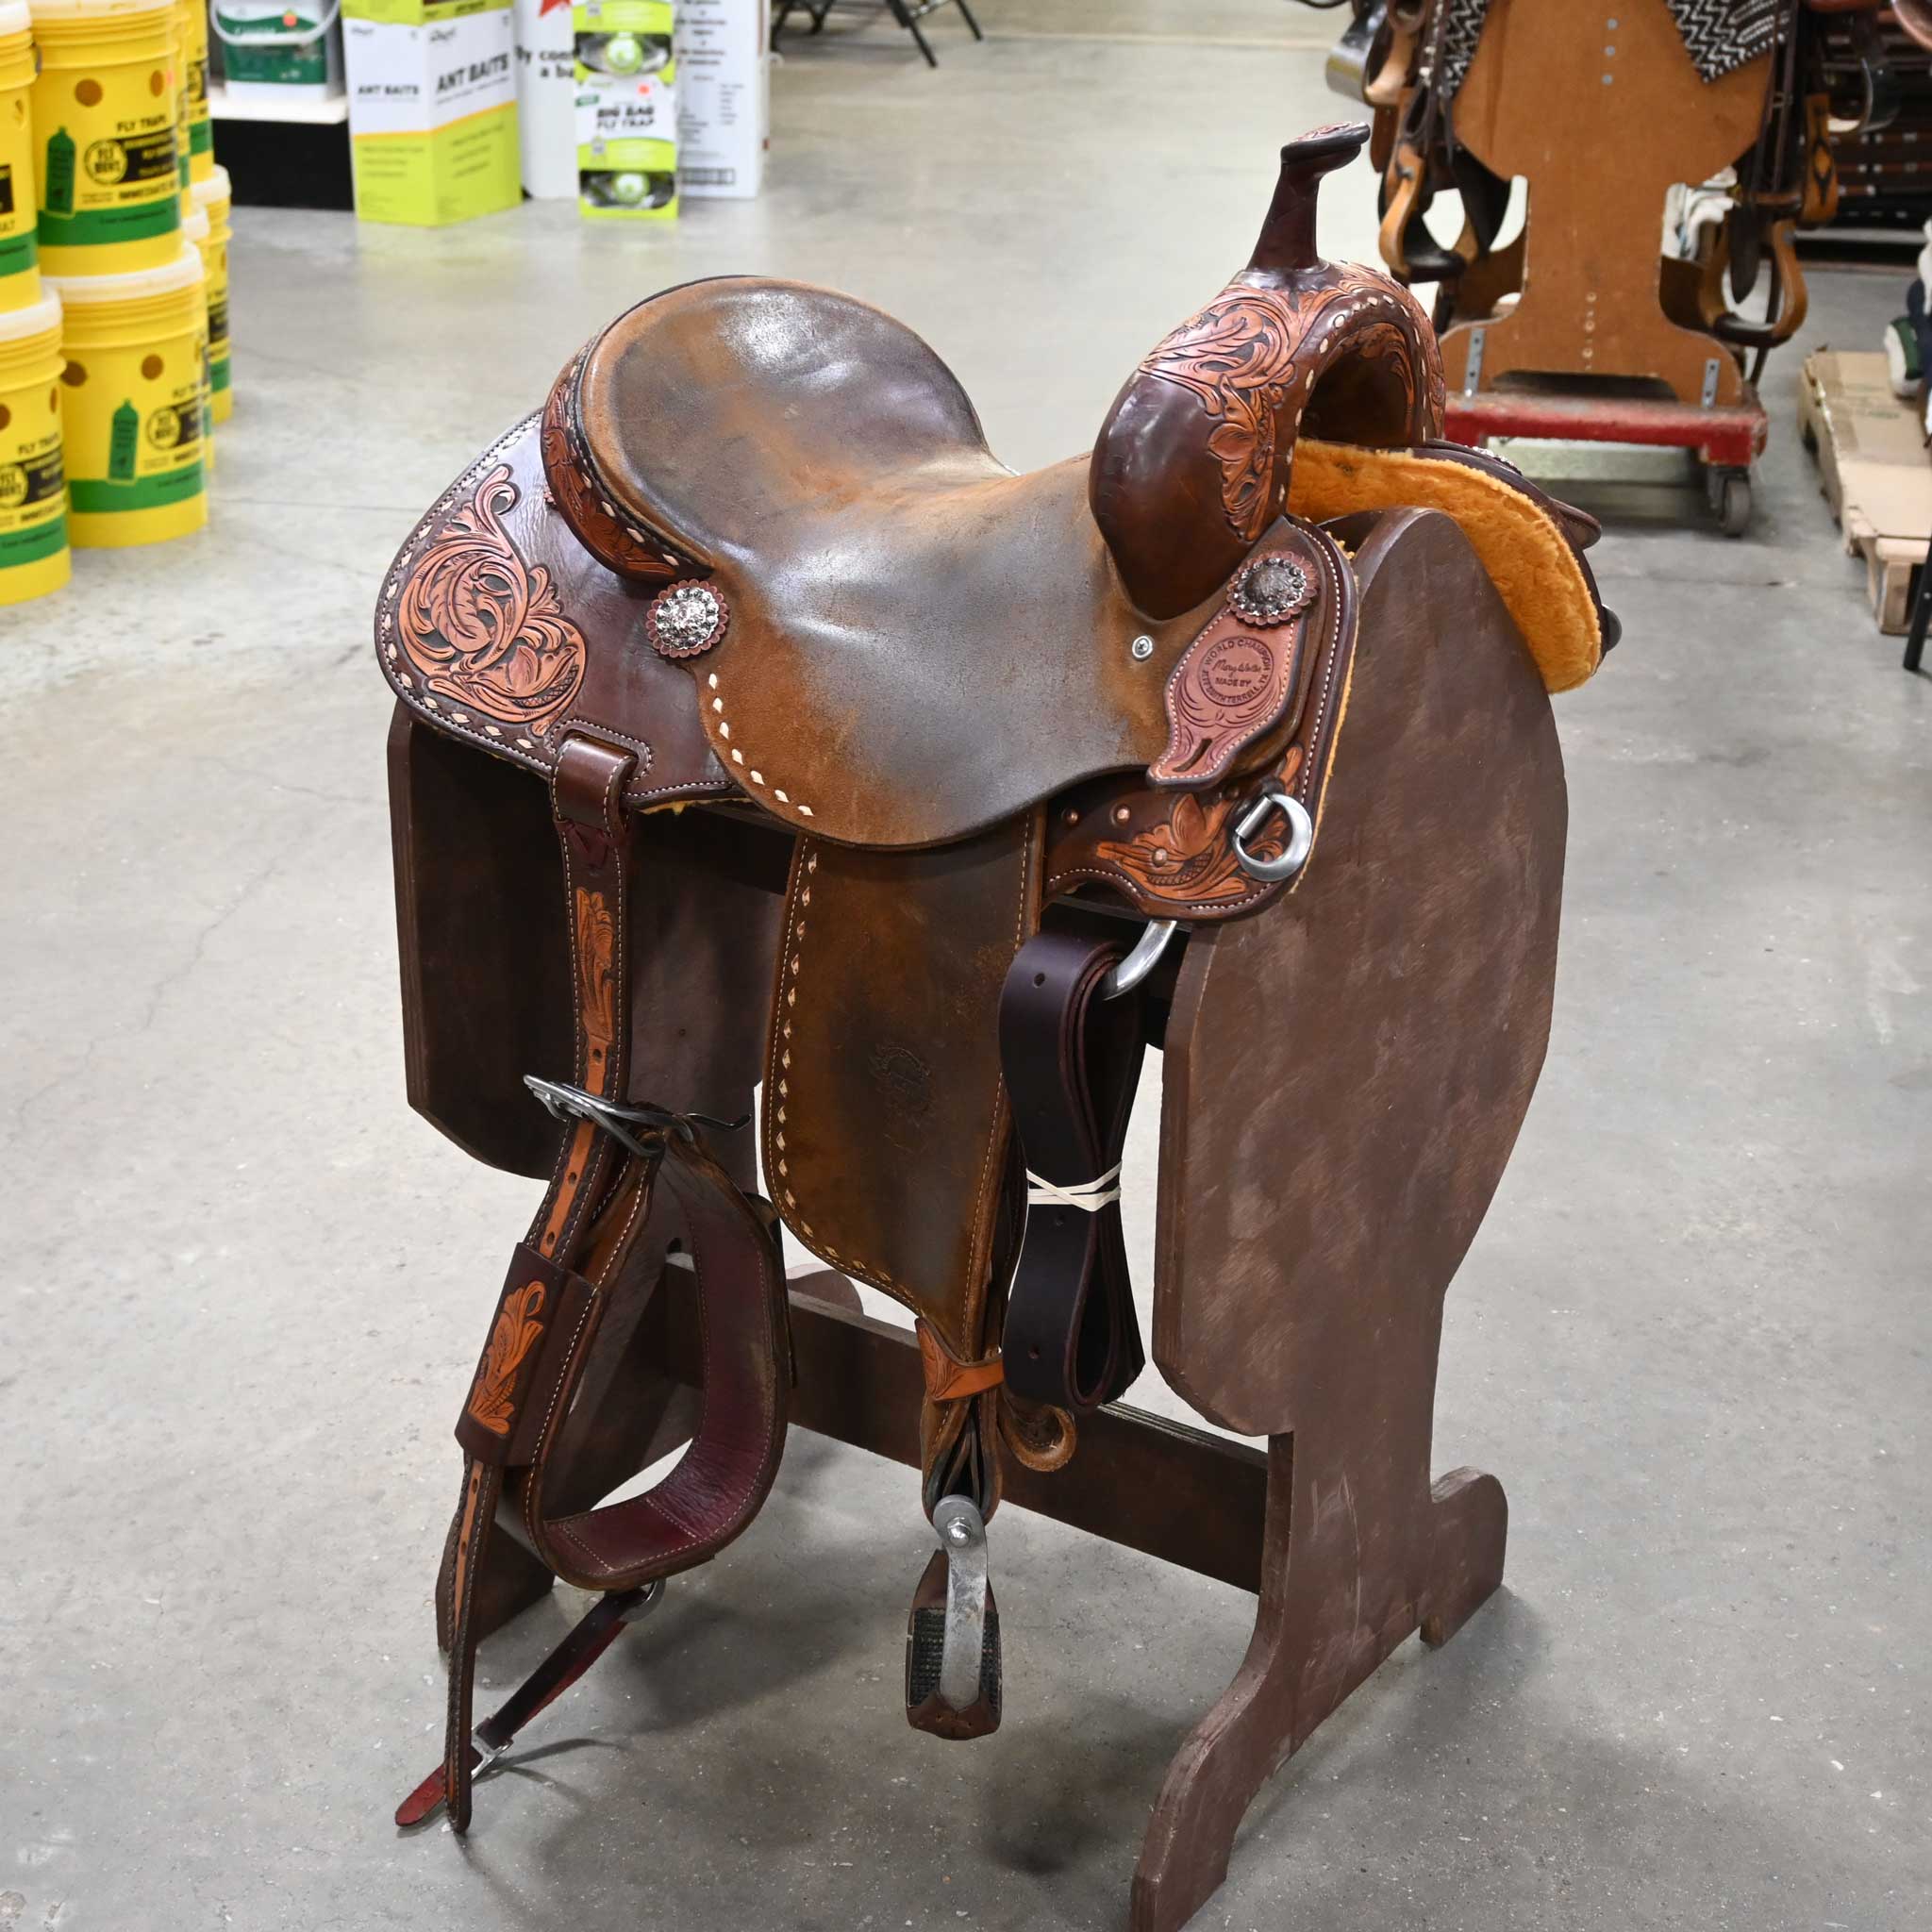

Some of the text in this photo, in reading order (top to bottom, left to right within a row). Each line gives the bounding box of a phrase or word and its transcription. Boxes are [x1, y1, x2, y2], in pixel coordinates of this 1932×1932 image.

[436, 66, 466, 93] ANT
[469, 52, 509, 83] BAITS
[358, 85, 419, 94] ANT BAITS
[117, 122, 136, 132] FLY
[1205, 639, 1271, 671] WORLD CHAMPION
[1215, 677, 1238, 687] MADE
